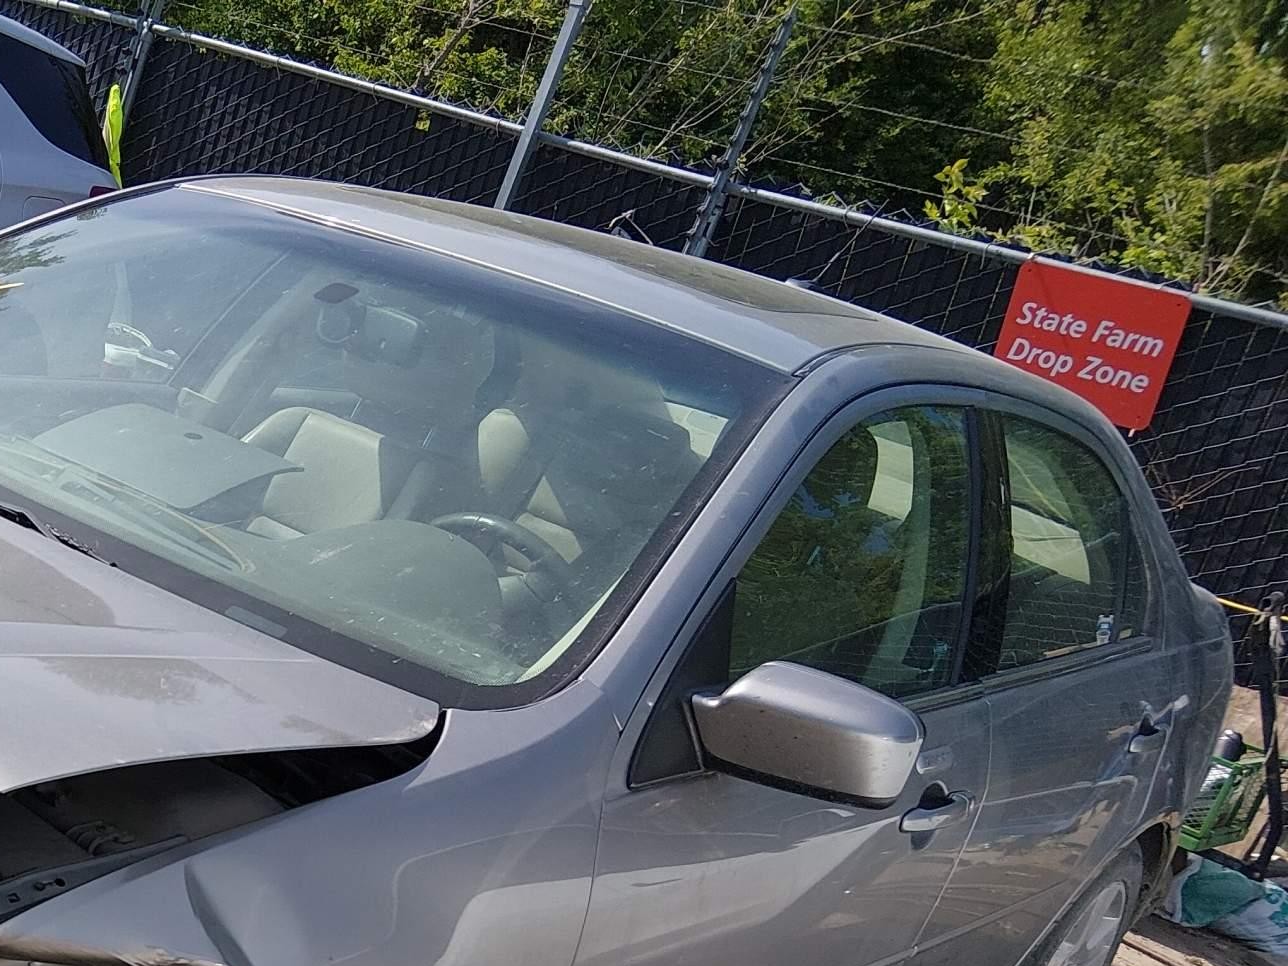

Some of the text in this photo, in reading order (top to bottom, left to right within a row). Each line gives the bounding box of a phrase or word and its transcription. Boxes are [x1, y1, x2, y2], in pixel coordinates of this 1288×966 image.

[1015, 302, 1164, 358] State Farm
[1006, 337, 1150, 394] Drop Zone
